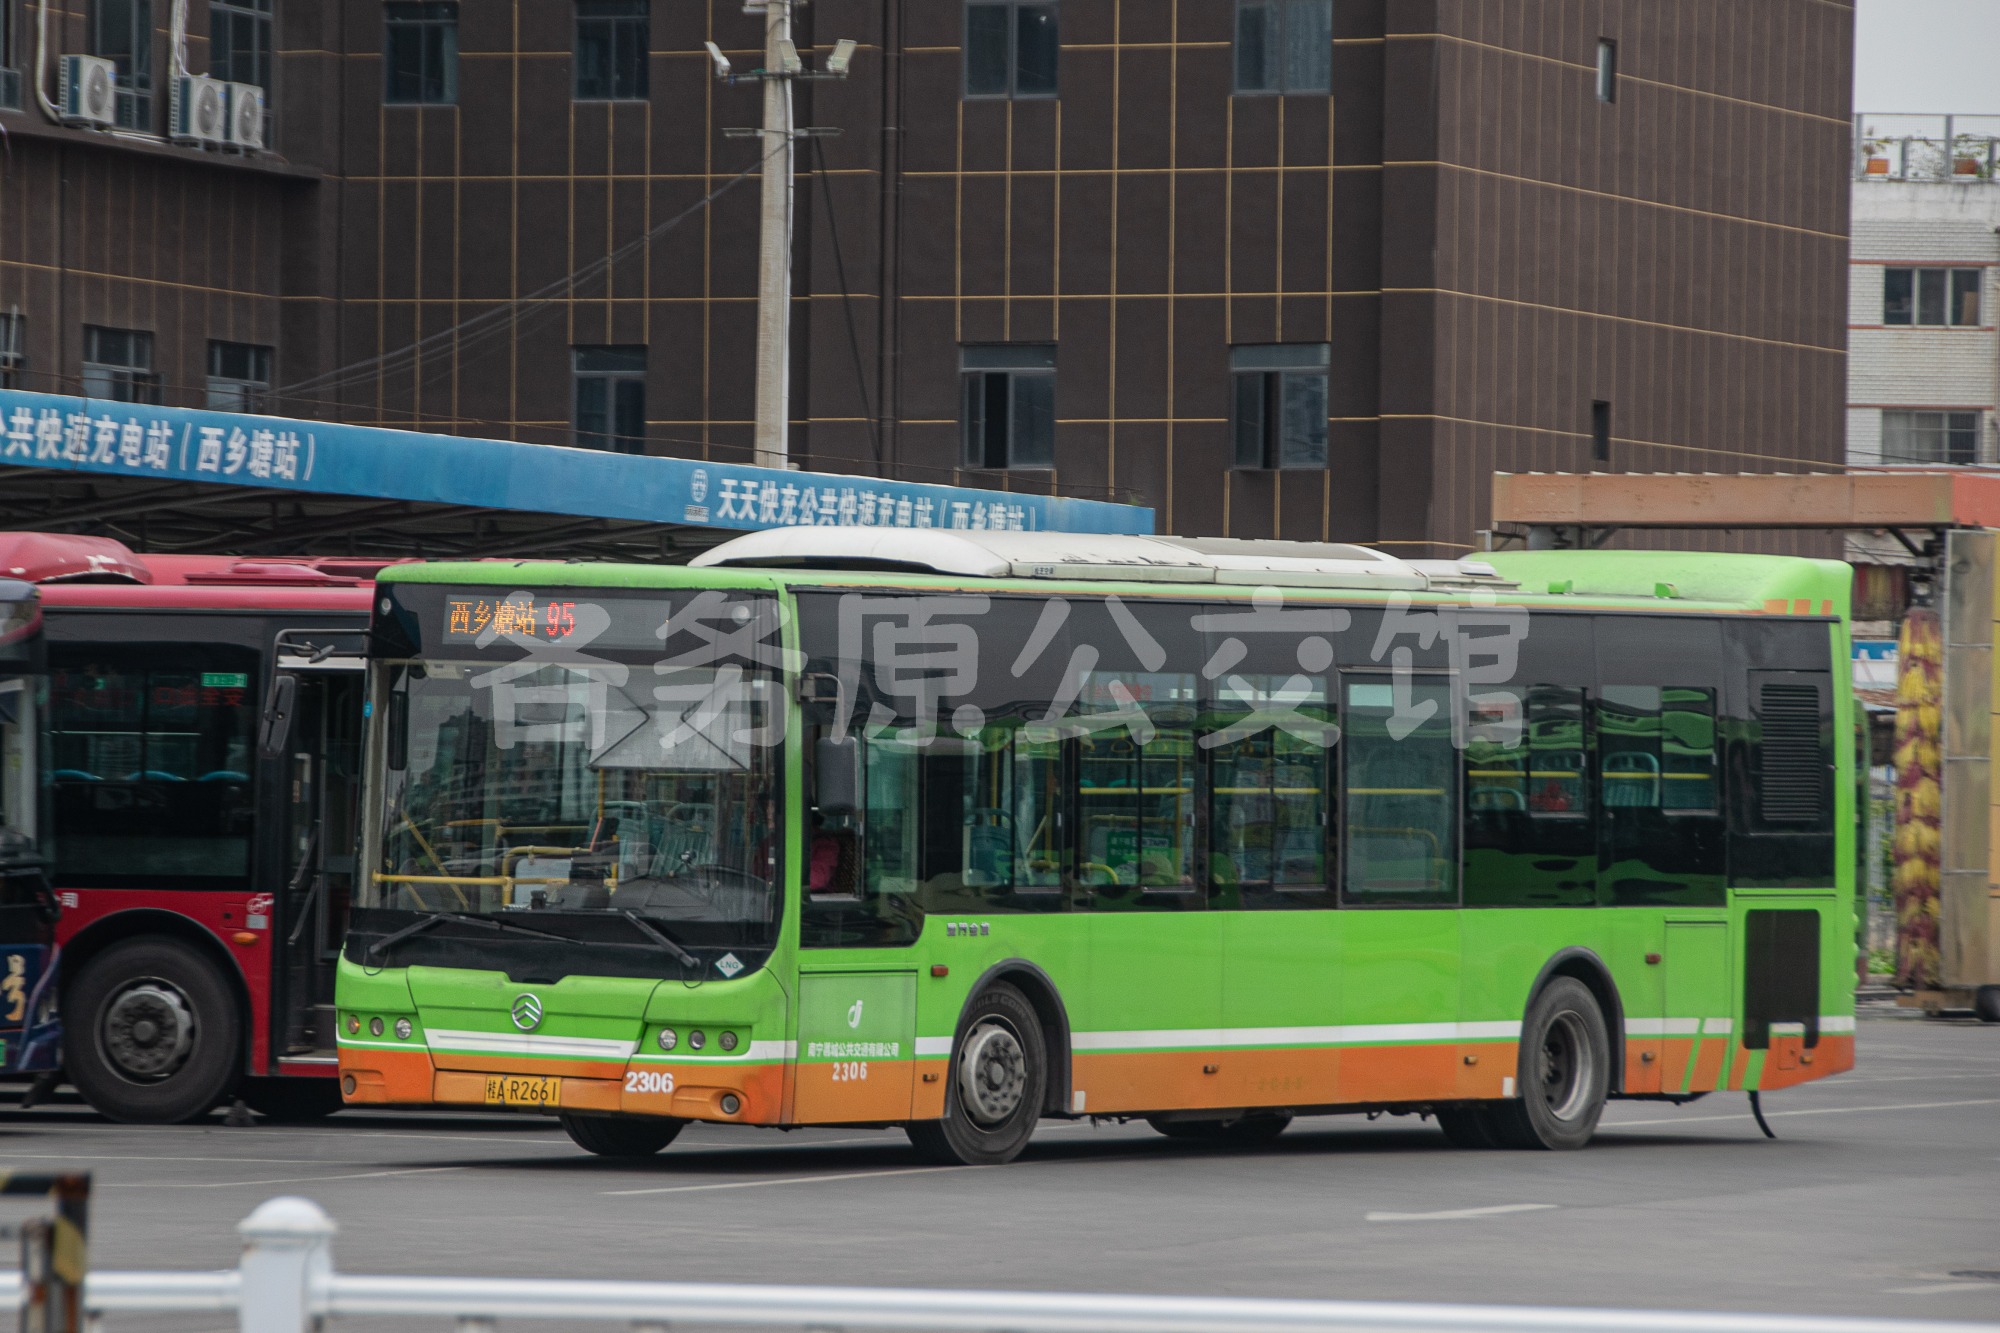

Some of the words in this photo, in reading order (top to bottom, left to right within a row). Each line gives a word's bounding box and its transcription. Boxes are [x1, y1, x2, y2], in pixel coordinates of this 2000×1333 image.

[0, 406, 315, 481] 共快速充电站（西乡塘站）
[449, 600, 538, 635] 西乡塘站
[546, 601, 576, 636] 95
[624, 1071, 674, 1093] 2306
[832, 1061, 868, 1082] 2306
